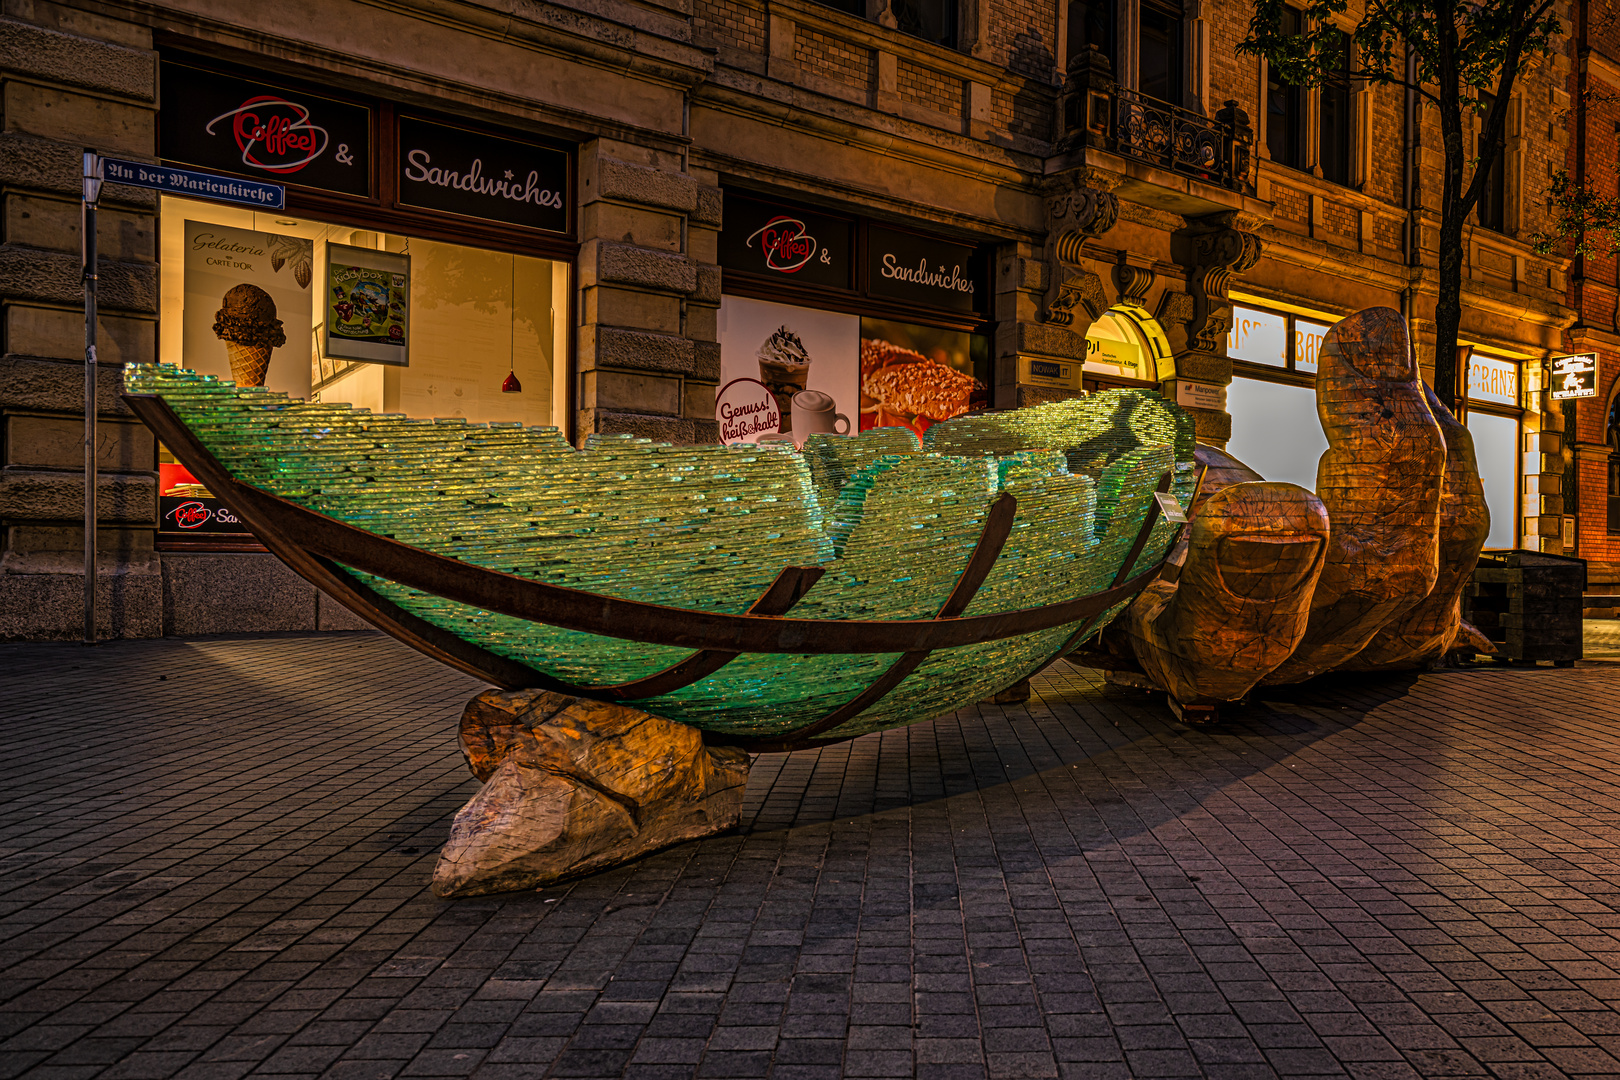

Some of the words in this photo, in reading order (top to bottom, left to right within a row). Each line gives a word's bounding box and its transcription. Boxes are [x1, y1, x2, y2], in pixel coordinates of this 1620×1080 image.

[239, 113, 313, 155] Coffee
[335, 143, 354, 166] &
[405, 149, 562, 209] Sandwiches
[108, 163, 133, 179] An
[139, 168, 166, 184] der
[170, 173, 275, 203] Marienkirche
[192, 232, 266, 256] Gelateria
[763, 229, 808, 260] Coffee
[820, 248, 831, 265] &
[881, 253, 974, 294] Sandwiches
[1032, 363, 1059, 375] NOWAK
[1062, 367, 1069, 376] IT
[720, 392, 770, 428] Genuss!
[177, 507, 206, 523] Coffee
